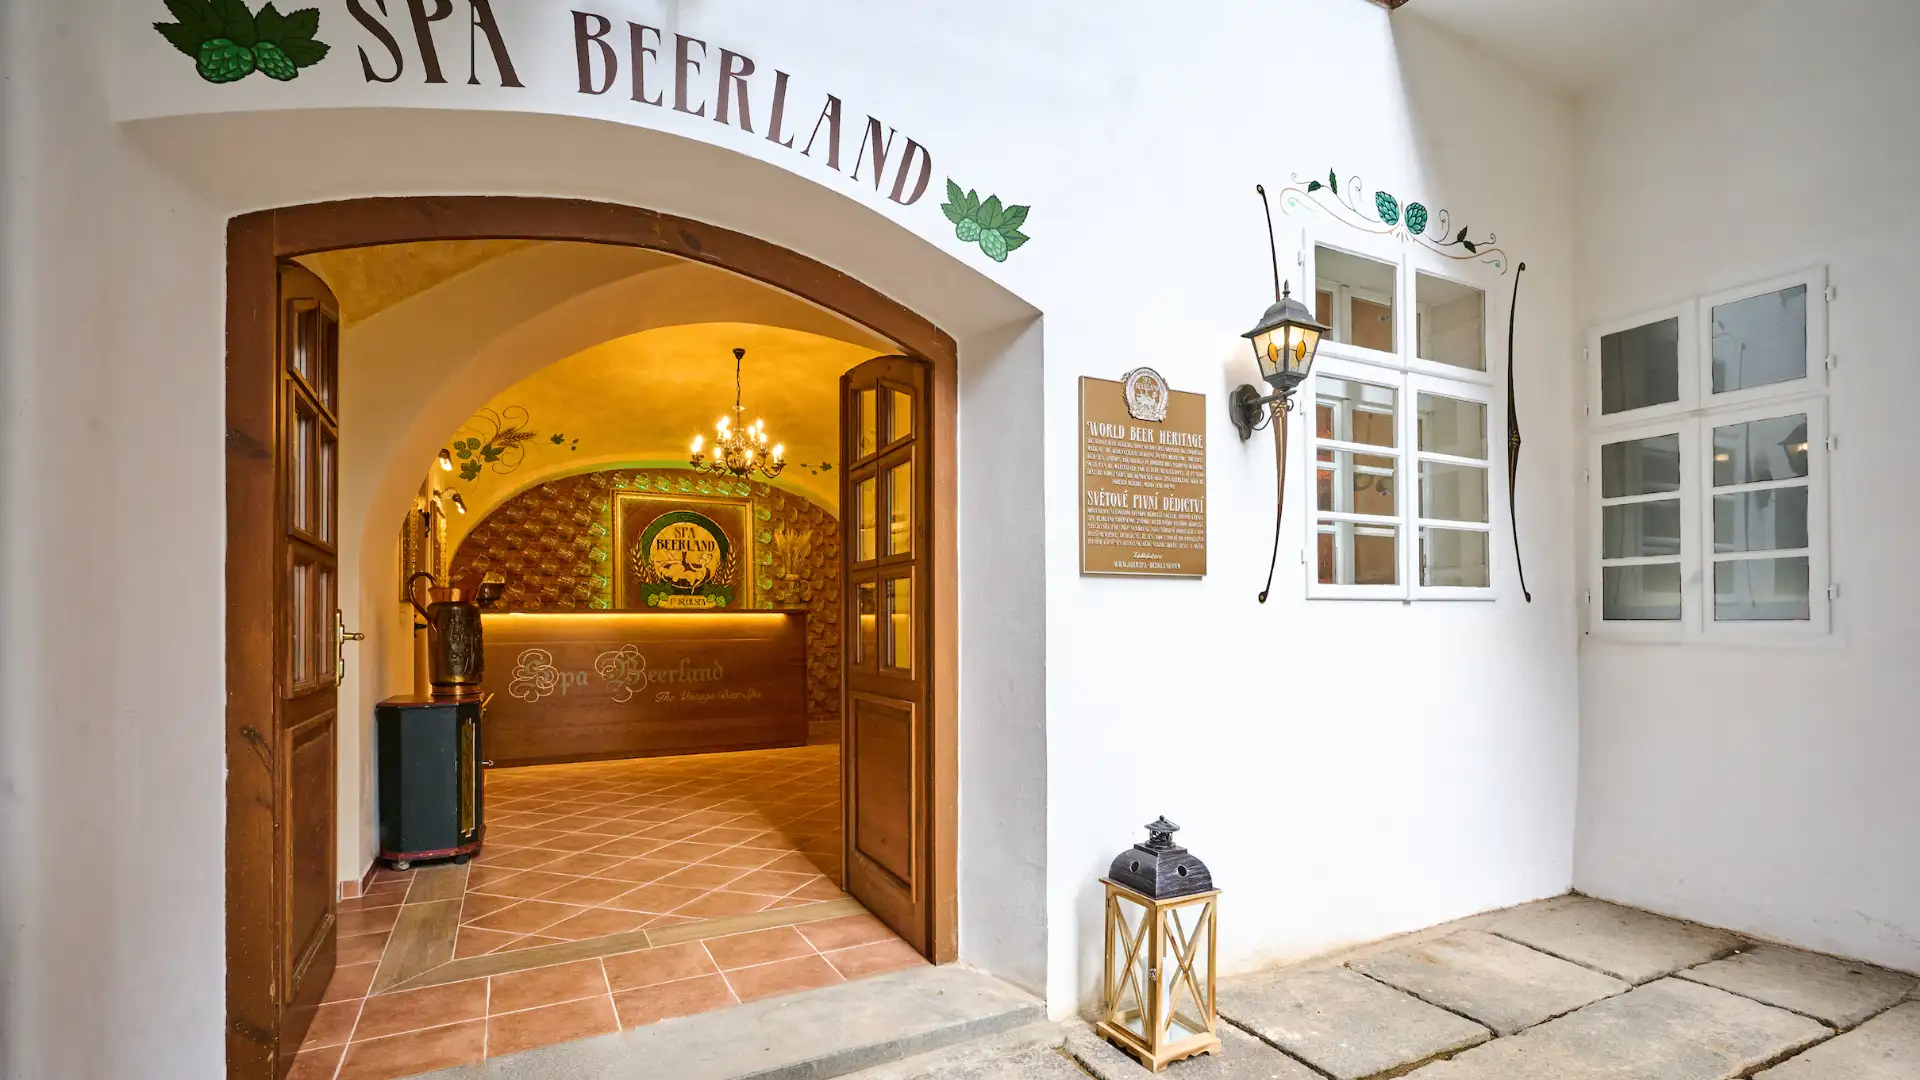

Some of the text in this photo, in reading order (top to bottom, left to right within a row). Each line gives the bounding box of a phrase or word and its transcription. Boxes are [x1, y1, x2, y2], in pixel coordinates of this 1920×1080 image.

[346, 0, 932, 206] SPA BEERLAND
[1087, 421, 1204, 449] WORLD BEER HERITAGE
[1087, 488, 1205, 514] SVĚTOVÉ PIVNÍ DĚDICTVÍ
[656, 539, 715, 552] BEERLAND
[674, 527, 696, 539] SPA
[510, 645, 724, 702] Spa Beerland
[655, 691, 676, 703] The
